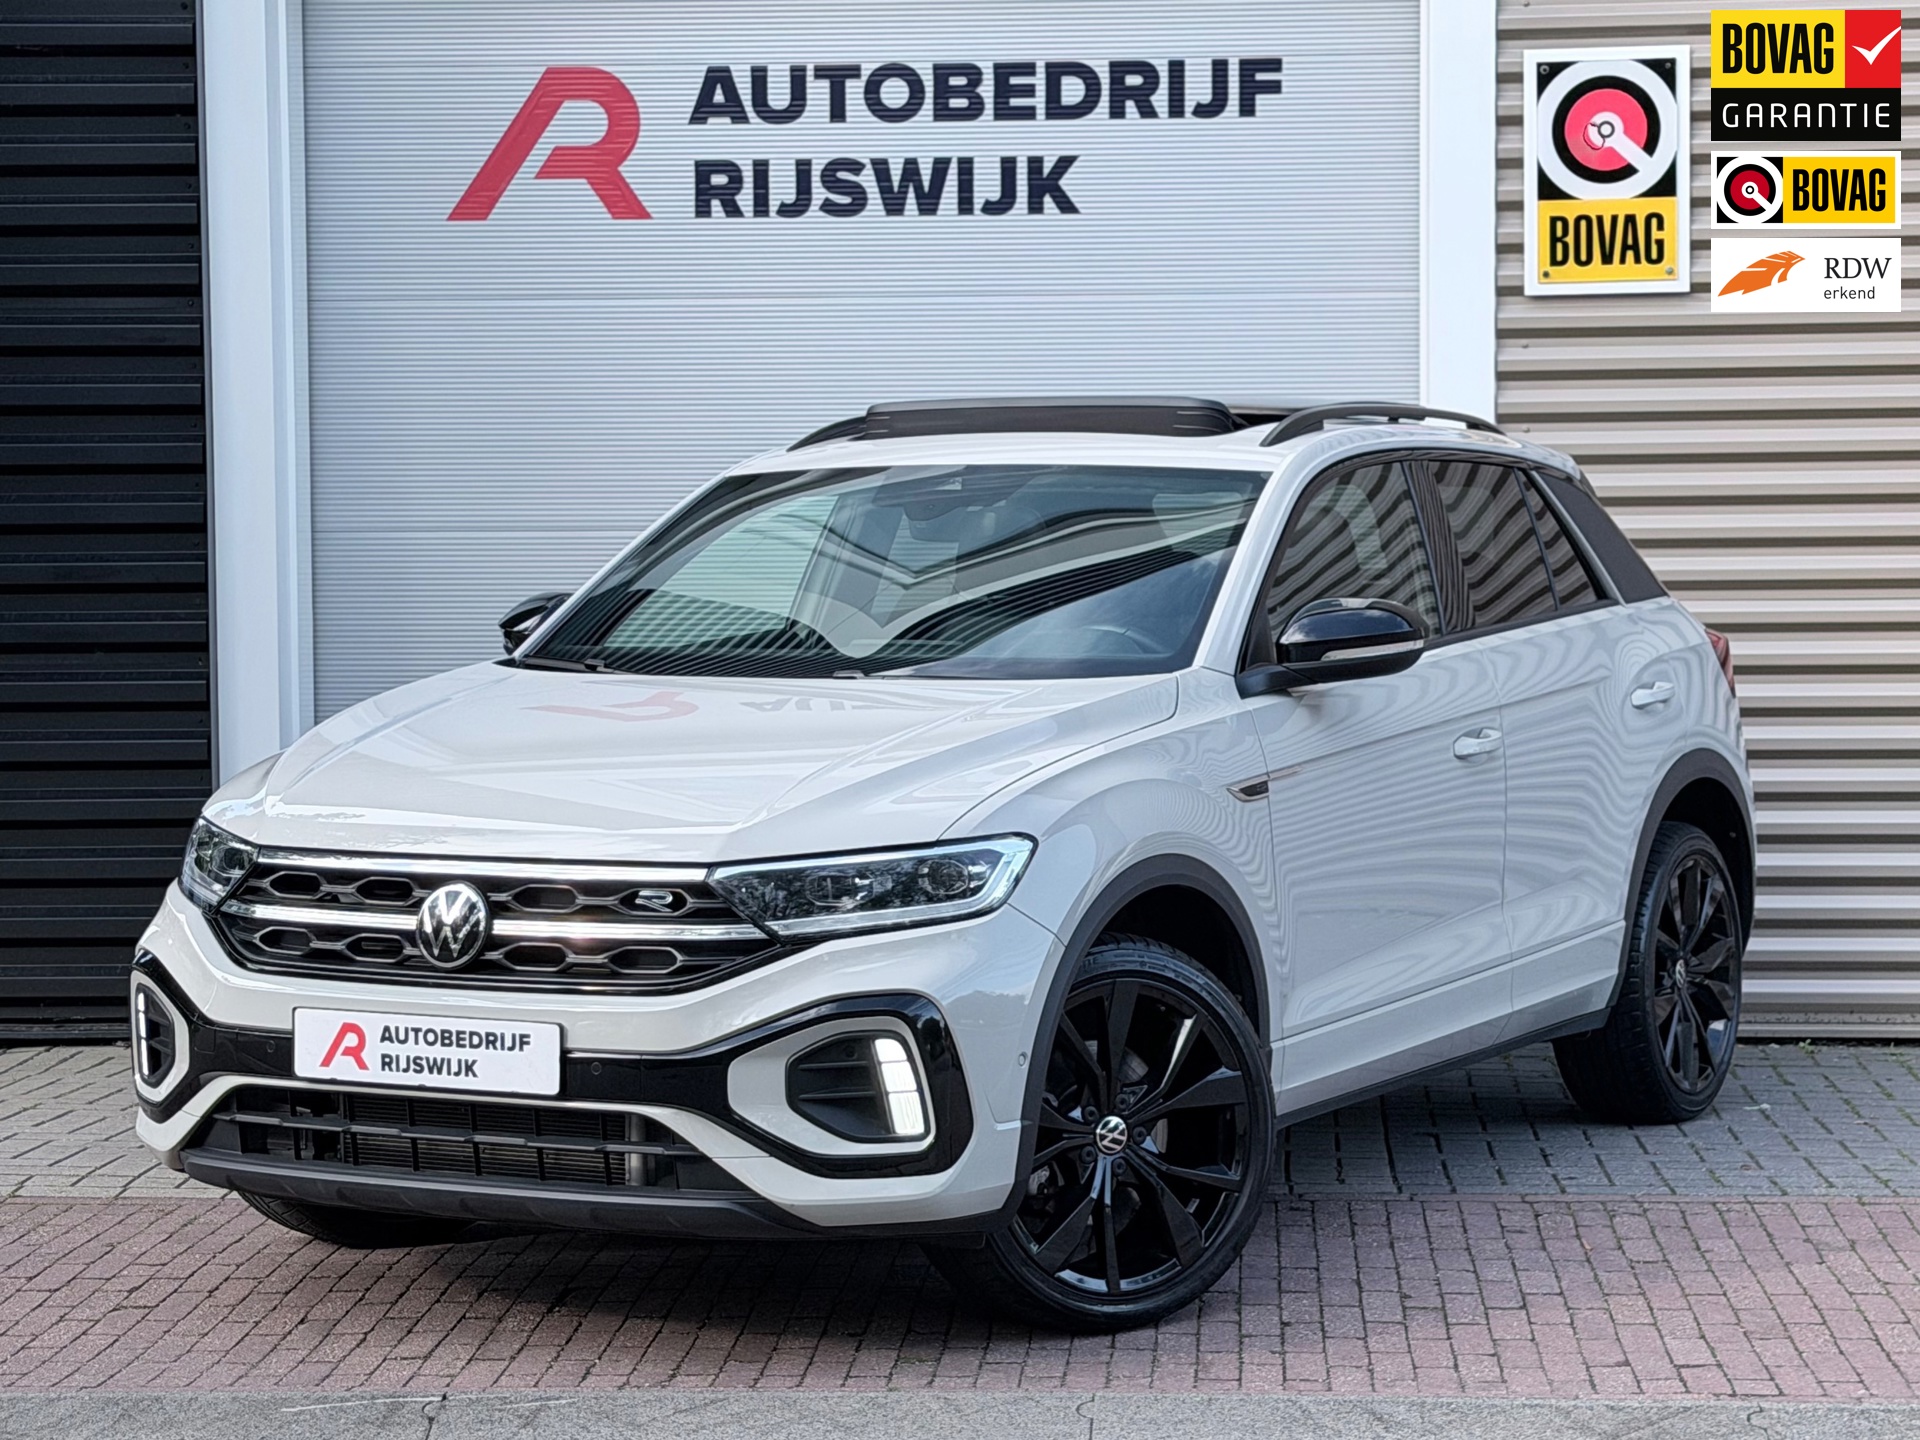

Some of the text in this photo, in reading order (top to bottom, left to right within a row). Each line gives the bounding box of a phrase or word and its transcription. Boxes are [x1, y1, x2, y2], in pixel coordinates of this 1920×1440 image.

[688, 57, 1283, 125] AUTOBEDRIJF
[693, 155, 1082, 219] RIJSWIJK
[1549, 212, 1665, 268] BOVAG
[635, 889, 674, 913] R
[380, 1025, 531, 1053] AUTOBEDRIJF
[380, 1053, 479, 1079] RIJSWIJK
